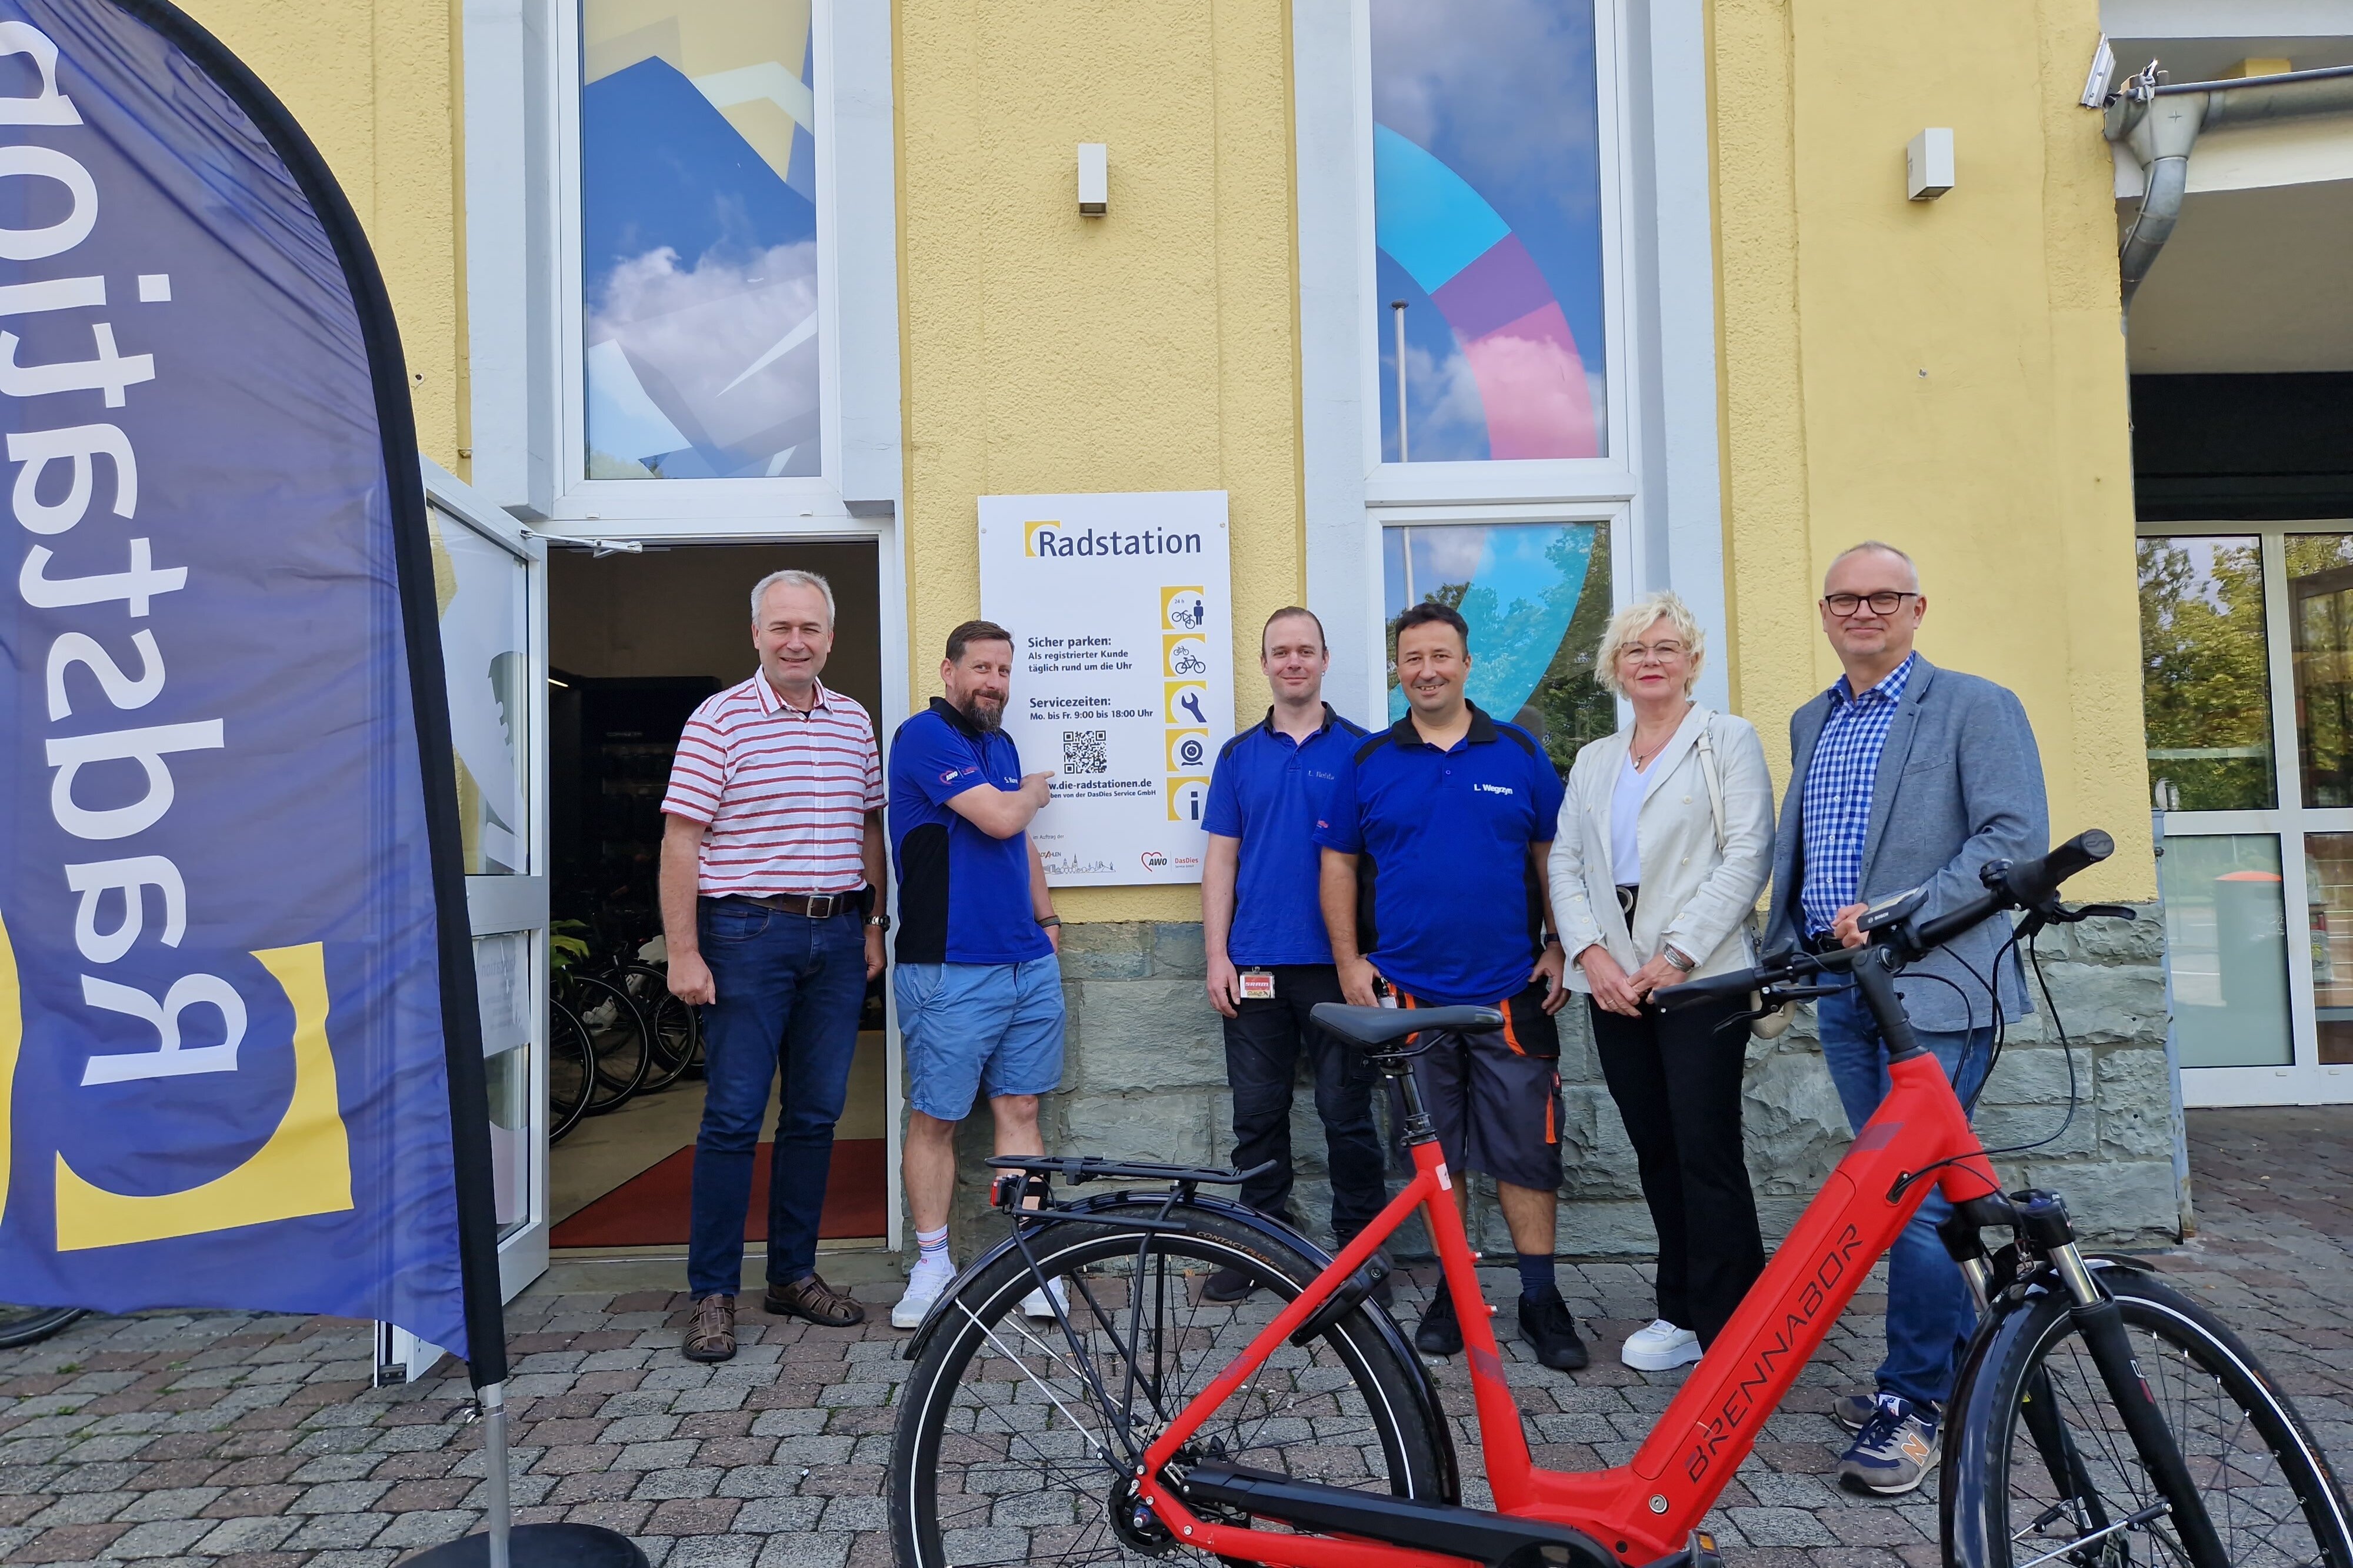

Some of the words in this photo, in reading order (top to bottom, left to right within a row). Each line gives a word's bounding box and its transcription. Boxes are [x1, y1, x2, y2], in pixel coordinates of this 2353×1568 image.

[1039, 526, 1201, 557] Radstation
[1028, 637, 1064, 648] Sicher
[1068, 636, 1111, 649] parken:
[1028, 652, 1042, 660] Als
[1045, 650, 1098, 661] registrierter
[1101, 649, 1129, 658] Kunde
[1028, 663, 1059, 674] täglich
[1061, 663, 1081, 671] rund
[1100, 662, 1114, 670] die
[1029, 696, 1111, 708] Servicezeiten:
[1074, 710, 1094, 719] 9:00
[1096, 710, 1108, 718] bis
[1111, 709, 1135, 718] 18:00
[1137, 709, 1153, 717] Uhr
[946, 770, 958, 781] AWO
[1048, 778, 1152, 790] w.die-radstationen.de
[1149, 858, 1167, 866] AWO
[1874, 912, 1889, 920] BOSCH
[1684, 1223, 1864, 1484] BRENNABOR
[1901, 1432, 1931, 1467] N
